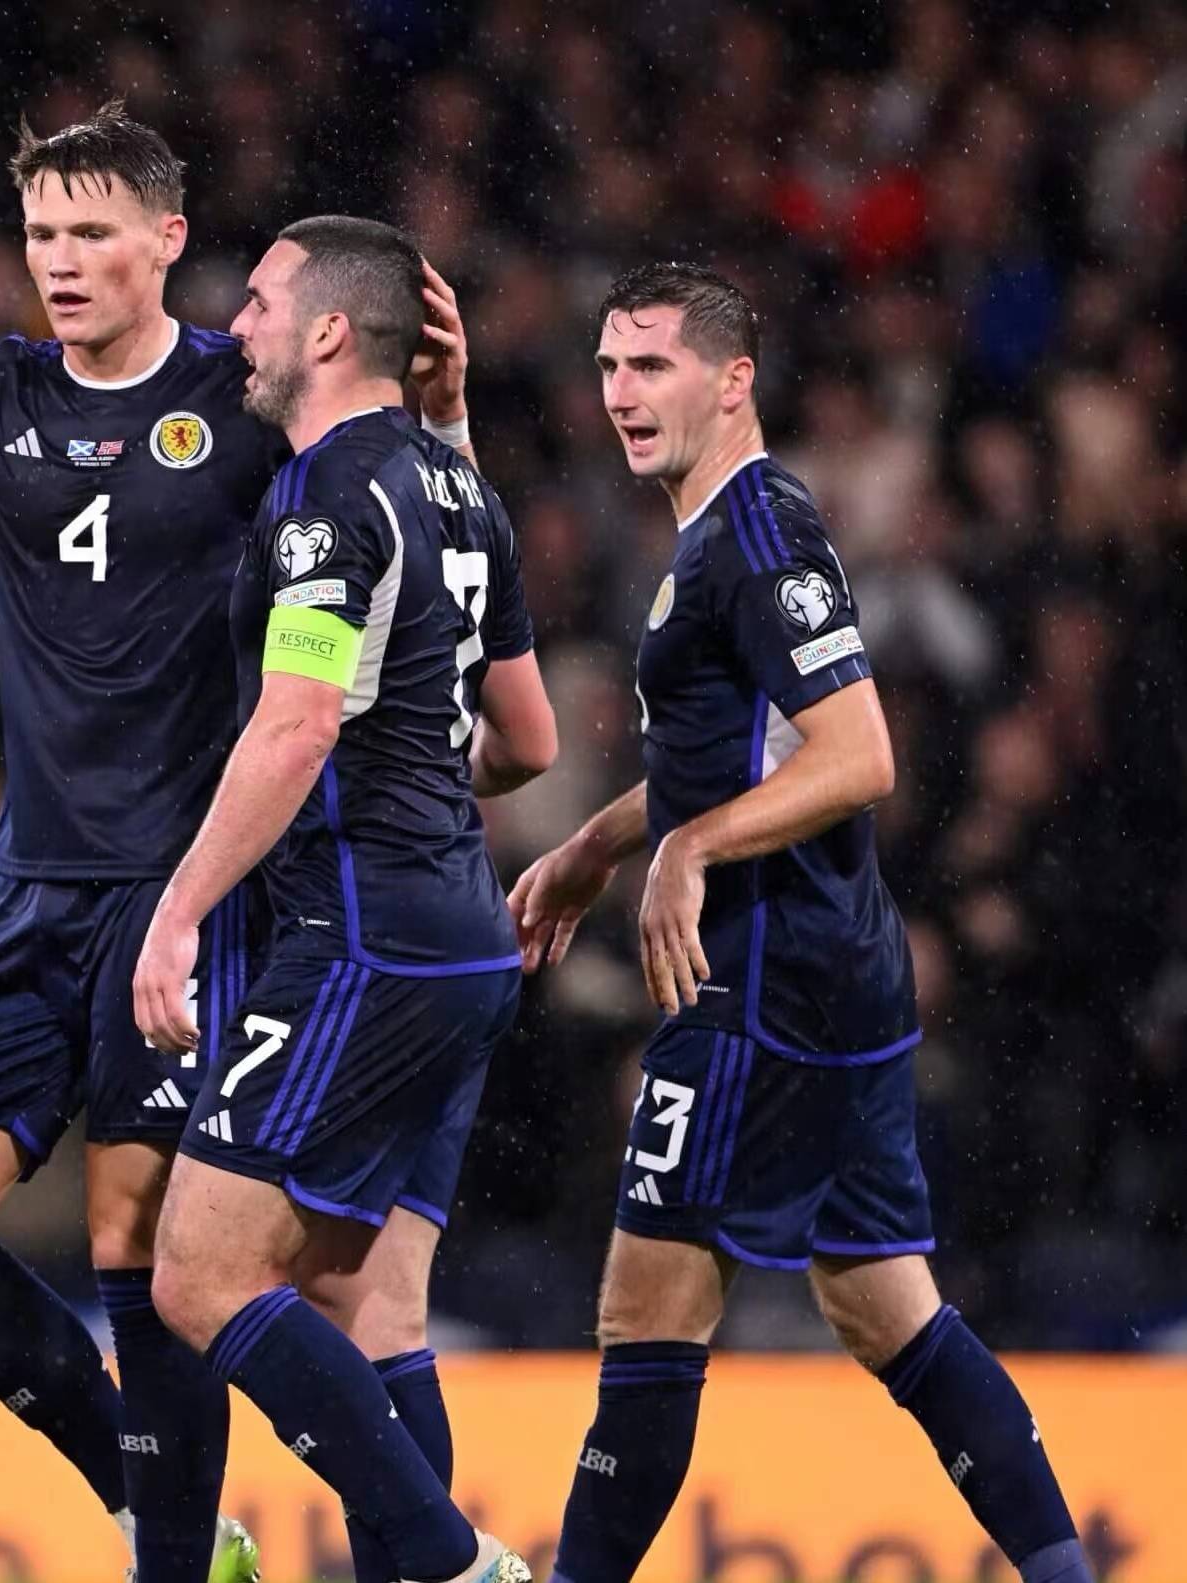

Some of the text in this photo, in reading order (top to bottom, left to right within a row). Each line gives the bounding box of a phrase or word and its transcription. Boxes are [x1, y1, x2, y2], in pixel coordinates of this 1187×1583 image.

[58, 494, 110, 582] 4
[279, 632, 336, 655] RESPECT
[220, 1014, 291, 1097] 7
[625, 1073, 695, 1173] 3
[118, 1432, 159, 1455] LBA
